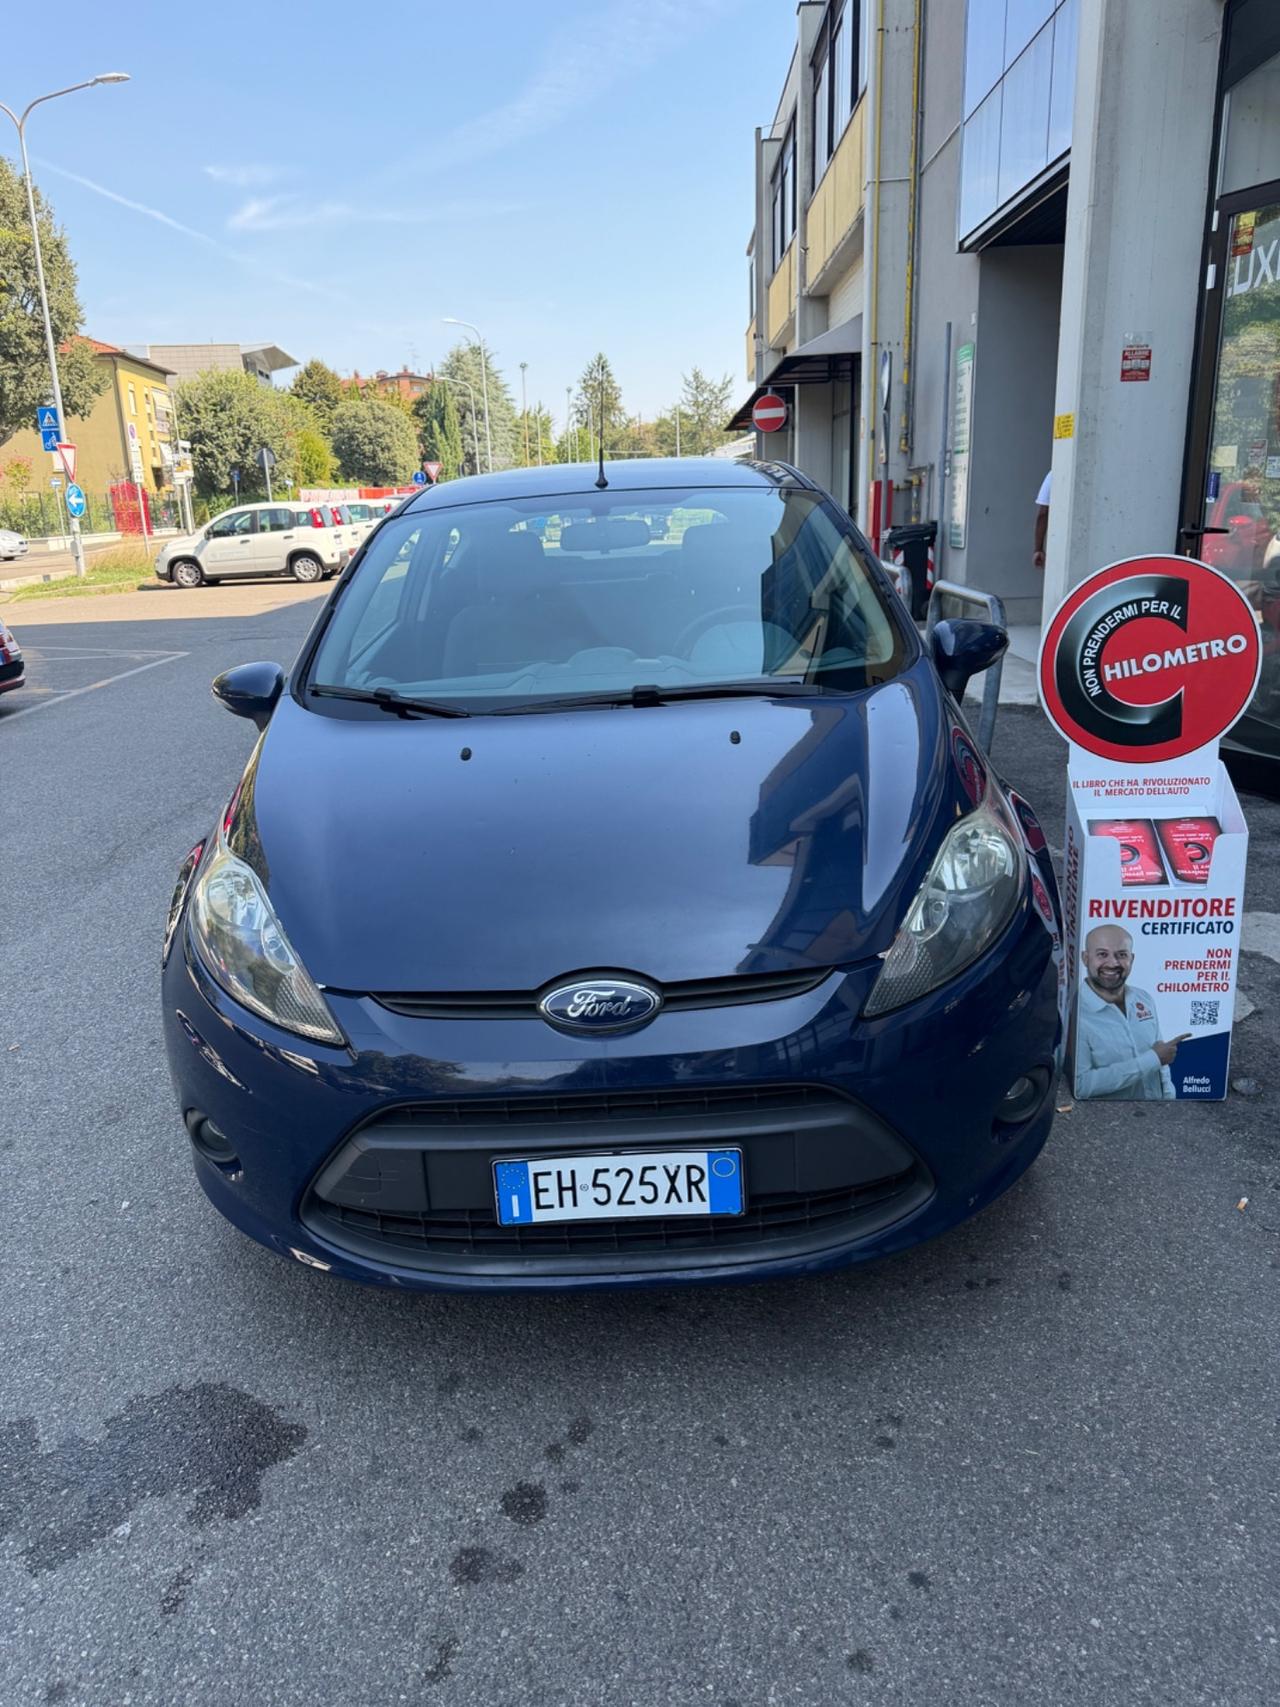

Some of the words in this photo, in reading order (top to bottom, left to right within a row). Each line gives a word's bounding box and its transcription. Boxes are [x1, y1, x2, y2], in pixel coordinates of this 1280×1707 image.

[1141, 600, 1169, 614] PER
[1170, 604, 1182, 620] IL
[1083, 603, 1138, 666] PRENDERMI
[1083, 668, 1102, 698] NON
[1072, 780, 1081, 789] IL
[1082, 779, 1106, 789] LIBRO
[1108, 778, 1125, 788] CHE
[1127, 778, 1139, 788] HA
[1142, 776, 1211, 787] RIVOLUZIONATO
[1094, 788, 1102, 797] IL
[1105, 787, 1145, 797] MERCATO
[1146, 786, 1190, 796] DELL'AUTO
[1088, 897, 1236, 918] RIVENDITORE
[1141, 921, 1234, 935] CERTIFICATO
[1206, 948, 1232, 959] NON
[1164, 960, 1231, 970] PRENDERMI
[1197, 971, 1218, 981] PER
[1157, 982, 1229, 993] CHILOMETRO
[567, 989, 632, 1018] Ford
[1183, 1076, 1211, 1084] Alfredo
[1183, 1084, 1212, 1093] Bellucci
